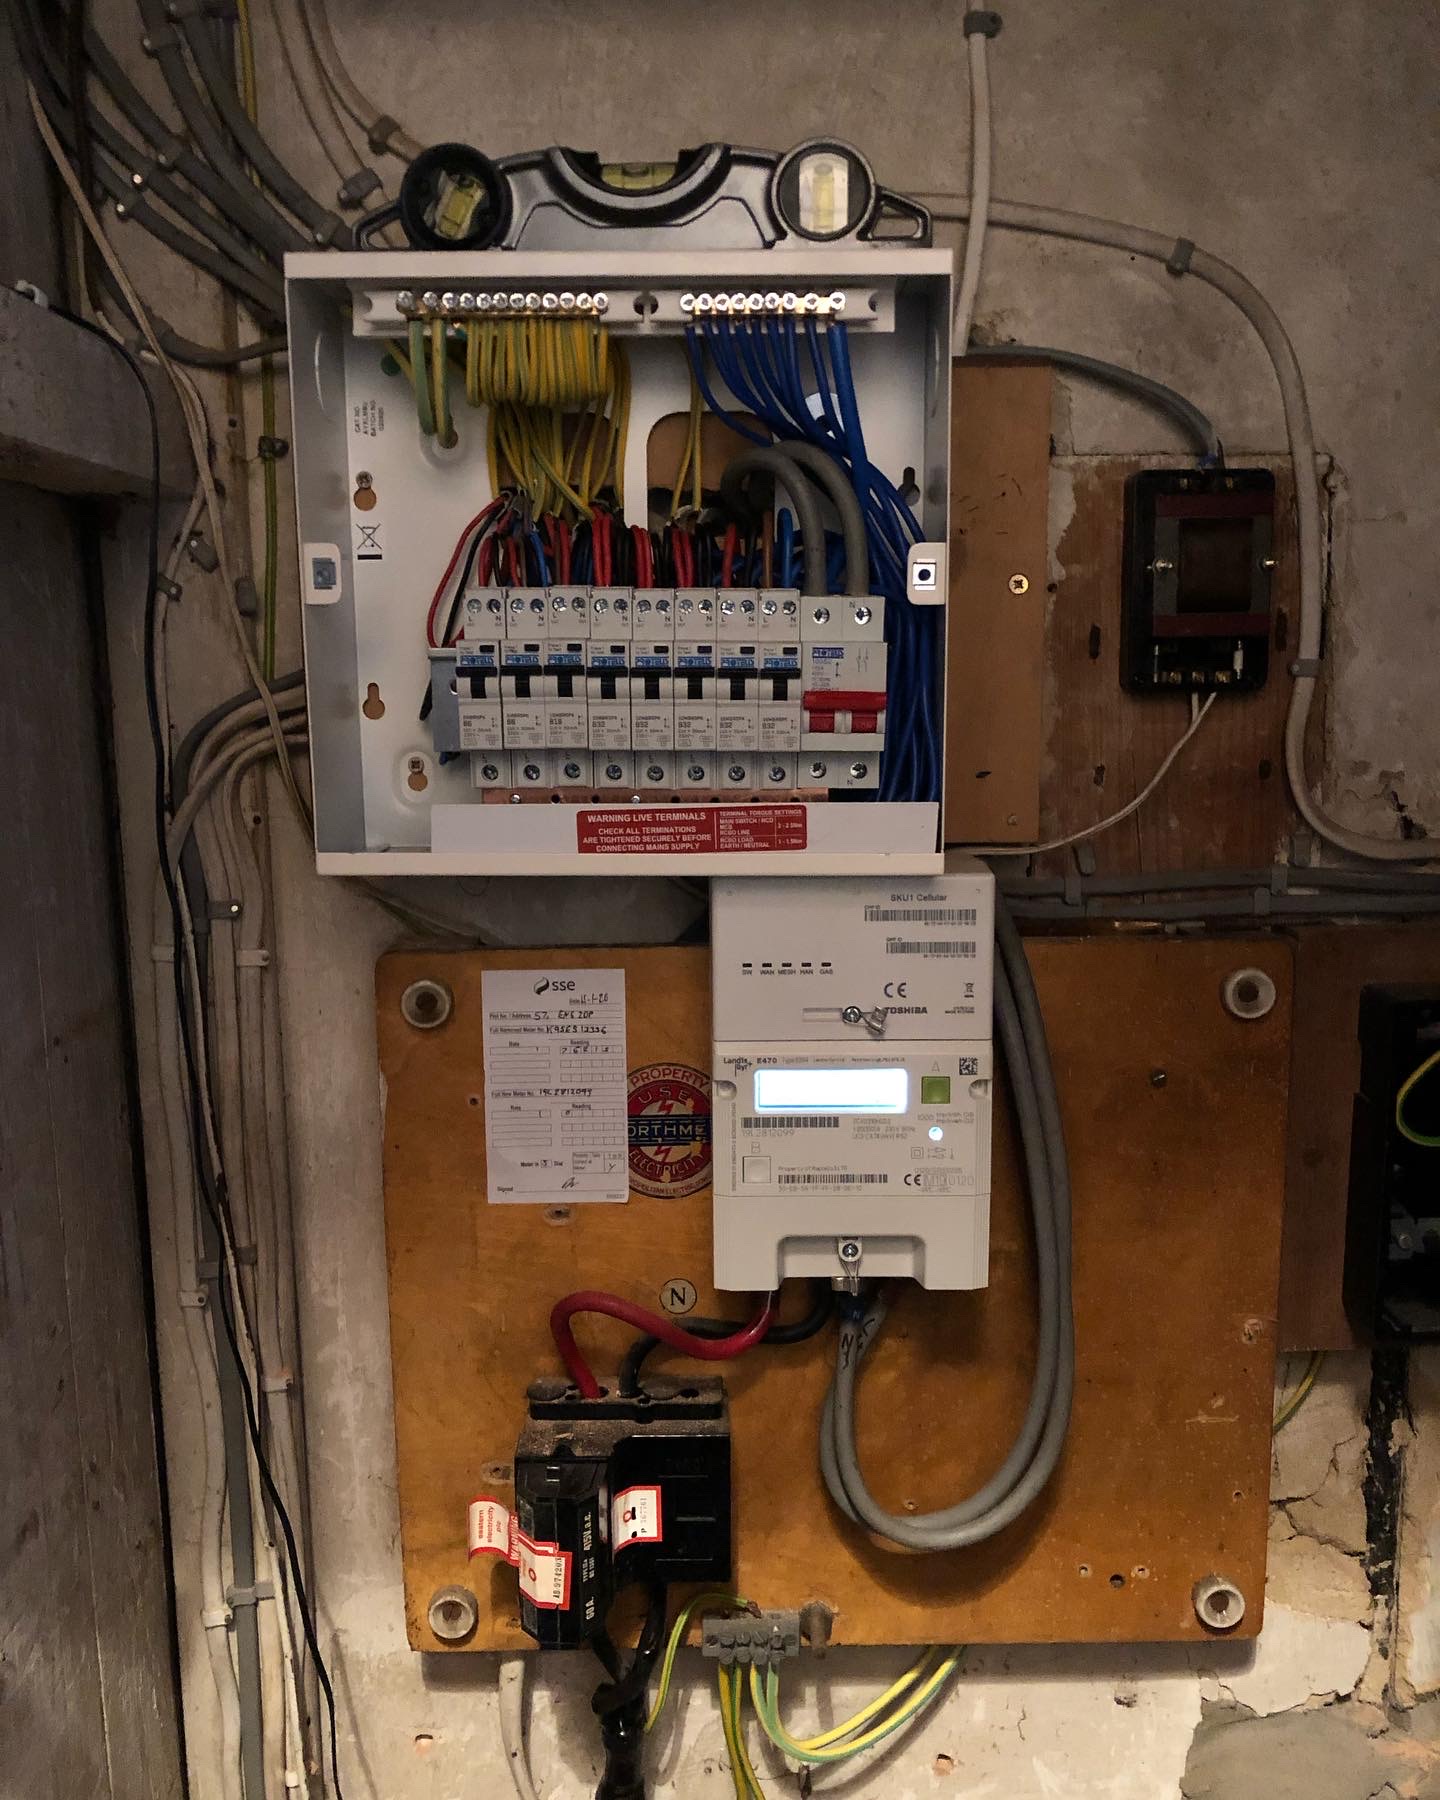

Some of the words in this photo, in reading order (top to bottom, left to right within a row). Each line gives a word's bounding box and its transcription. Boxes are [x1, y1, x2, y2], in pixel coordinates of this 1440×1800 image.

[587, 814, 631, 823] WARNING
[632, 813, 652, 822] LIVE
[655, 812, 706, 821] TERMINALS
[598, 827, 624, 835] CHECK
[642, 825, 696, 834] TERMINATIONS
[582, 836, 599, 844] ARE
[600, 835, 641, 843] TIGHTENED
[642, 834, 680, 843] SECURELY
[682, 833, 712, 841] BEFORE
[596, 844, 645, 852] CONNECTING
[646, 843, 670, 851] MAINS
[670, 842, 700, 850] SUPPLY
[890, 894, 913, 902] SKU1
[916, 894, 948, 902] Cellular
[551, 980, 576, 991] sse
[885, 1006, 928, 1014] TOSHIBA
[631, 1067, 709, 1090] PROPERTY
[638, 1086, 690, 1106] USE
[628, 1148, 705, 1177] ELECTRICITY
[670, 1288, 686, 1306] N
[487, 1506, 495, 1543] electricity
[510, 1515, 519, 1560] WARNING
